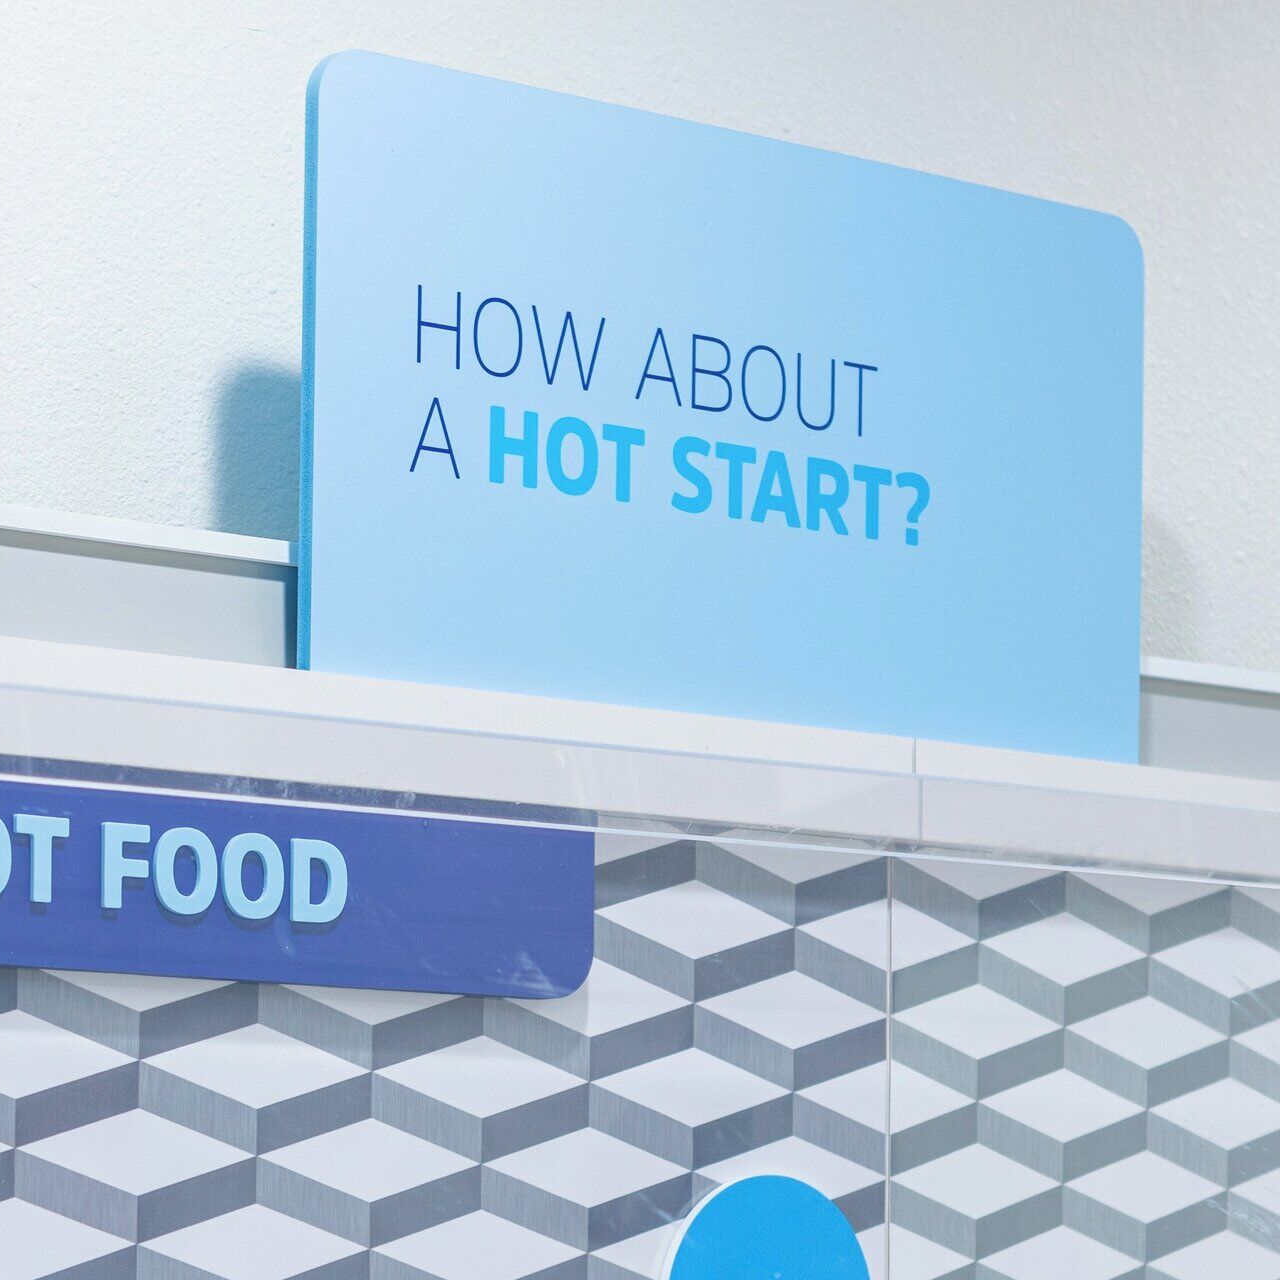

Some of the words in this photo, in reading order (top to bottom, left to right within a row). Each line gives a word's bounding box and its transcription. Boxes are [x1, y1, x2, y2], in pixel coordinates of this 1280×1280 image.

[415, 284, 606, 391] HOW
[635, 327, 878, 437] ABOUT
[409, 397, 462, 480] A
[488, 404, 645, 504] HOT
[671, 435, 931, 546] START?
[100, 820, 349, 924] FOOD
